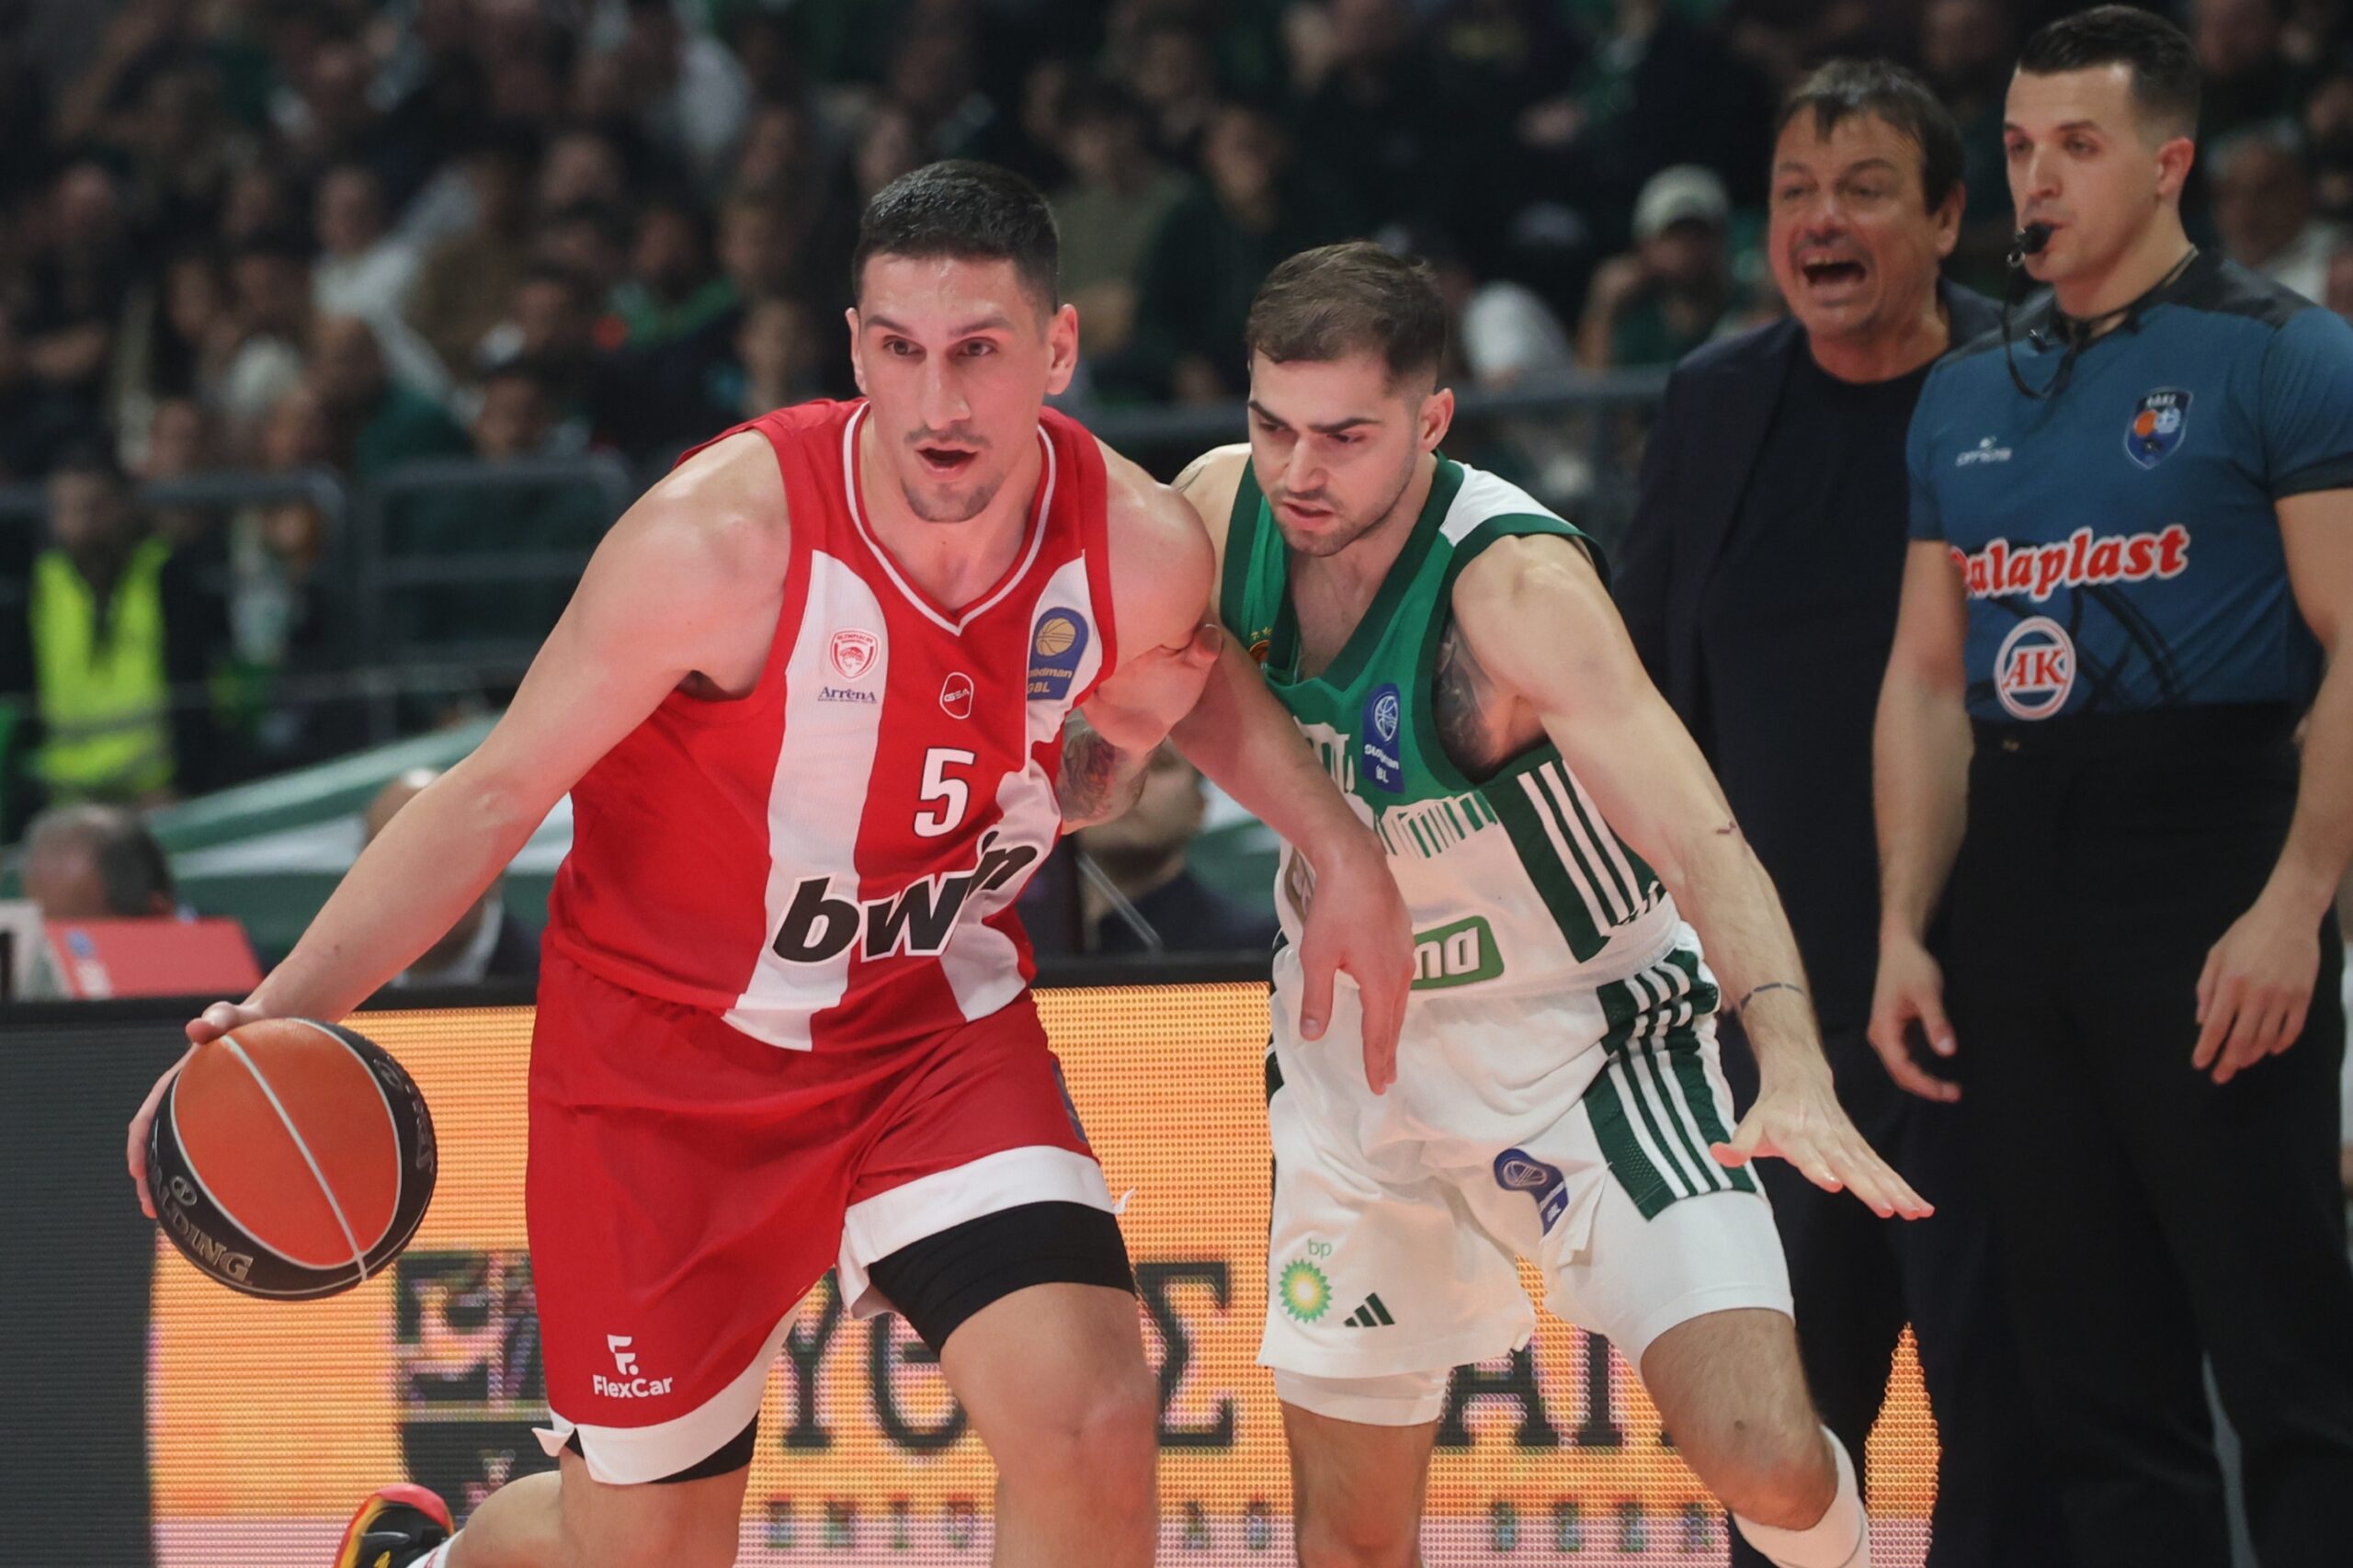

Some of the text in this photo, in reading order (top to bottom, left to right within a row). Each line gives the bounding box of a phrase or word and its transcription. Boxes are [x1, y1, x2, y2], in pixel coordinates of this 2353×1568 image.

[2001, 648, 2069, 690] AK
[914, 747, 975, 837] 5
[1308, 1237, 1332, 1260] bp
[592, 1374, 673, 1398] FlexCar
